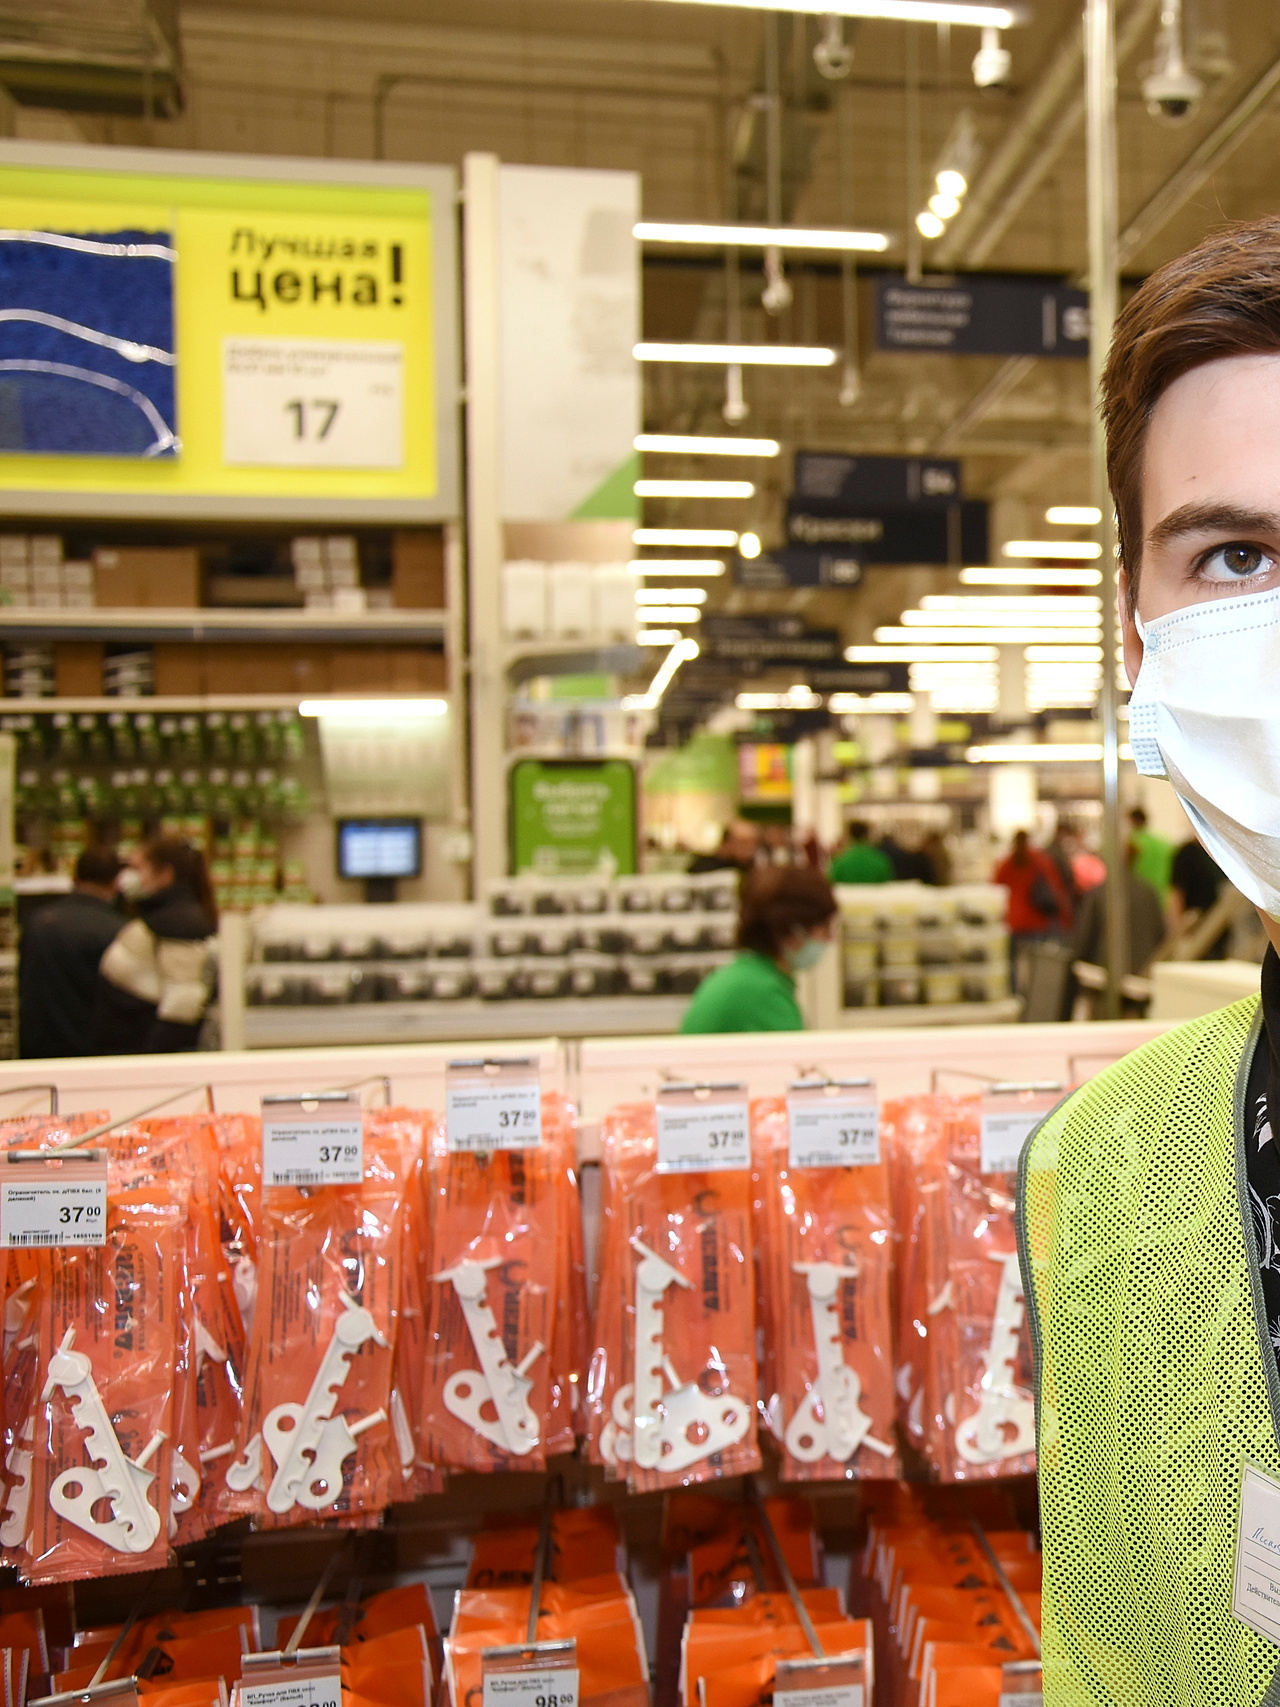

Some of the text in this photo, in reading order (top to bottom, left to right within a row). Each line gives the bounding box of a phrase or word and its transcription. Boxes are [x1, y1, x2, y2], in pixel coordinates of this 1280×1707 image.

[231, 227, 377, 262] Лучшая
[285, 398, 342, 441] 17
[499, 1110, 520, 1128] 37
[709, 1131, 730, 1148] 37
[839, 1129, 859, 1146] 37
[320, 1145, 358, 1162] 37 00
[59, 1206, 101, 1223] 37 00
[535, 1693, 574, 1707] 98 00
